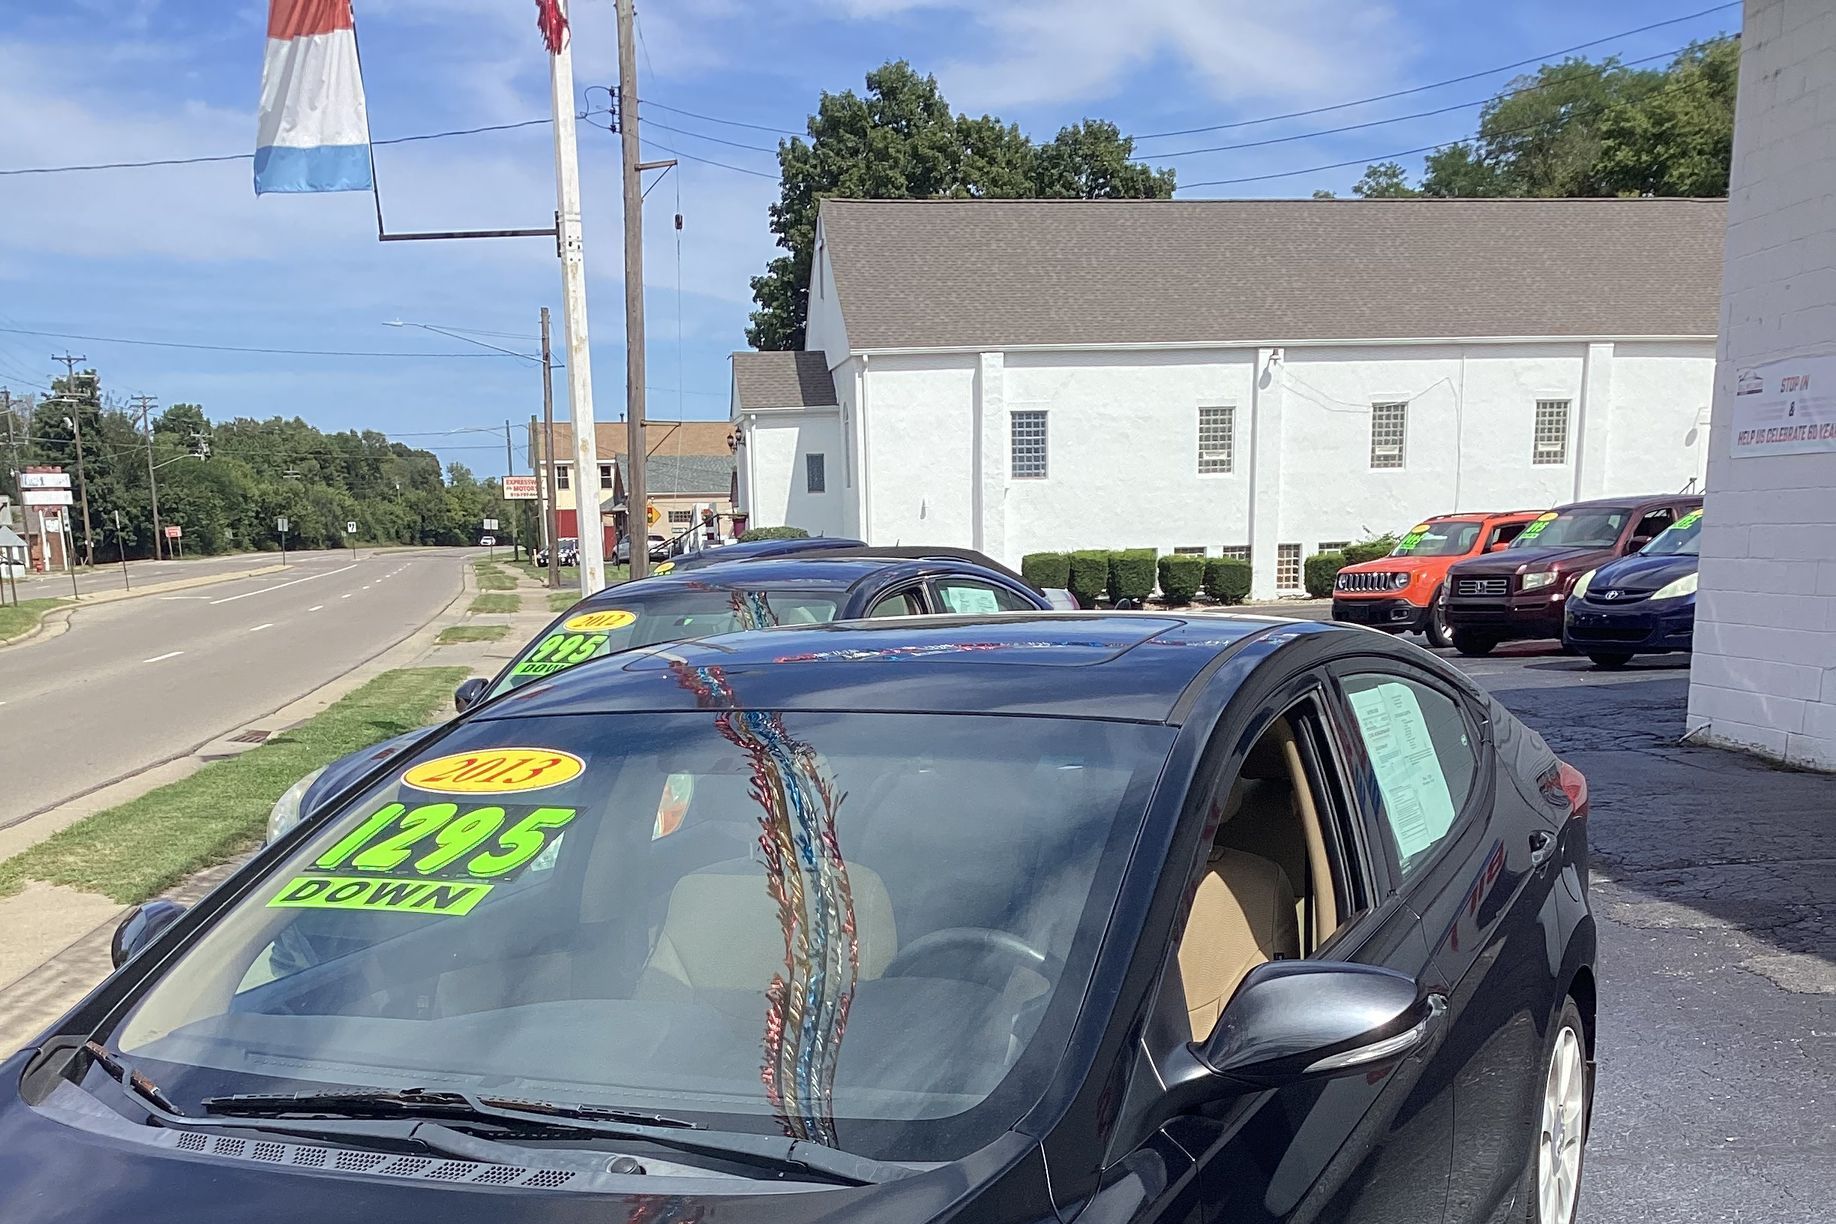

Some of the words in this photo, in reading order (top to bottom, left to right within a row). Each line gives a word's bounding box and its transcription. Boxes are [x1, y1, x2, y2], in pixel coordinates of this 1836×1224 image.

[1780, 376, 1800, 393] STOP
[1800, 375, 1809, 391] IN
[1738, 430, 1755, 446] HELP
[1756, 429, 1766, 444] US
[1766, 425, 1807, 443] CELEBRATE
[1819, 422, 1836, 439] YEA
[573, 614, 626, 628] 2012
[531, 634, 609, 663] 995
[520, 663, 565, 674] DOW
[422, 758, 562, 784] 2013
[315, 801, 577, 878] 1295
[281, 879, 478, 910] DOWN
